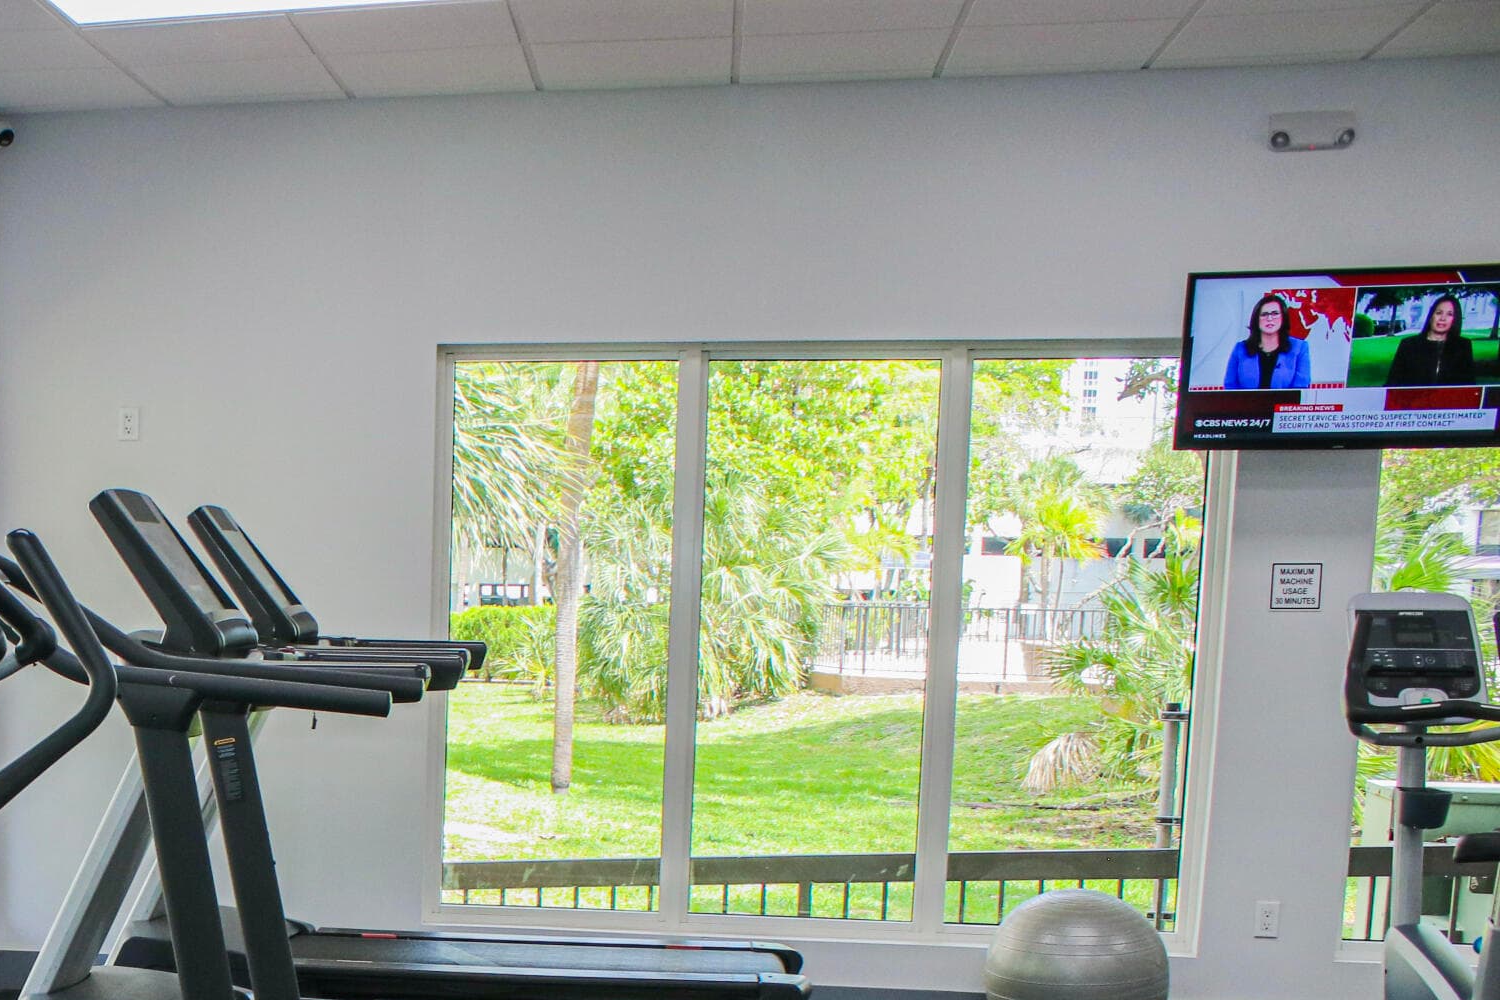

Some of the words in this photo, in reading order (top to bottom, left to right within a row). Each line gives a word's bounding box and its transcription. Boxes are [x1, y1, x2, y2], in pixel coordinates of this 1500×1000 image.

[1414, 412, 1486, 420] "UNDERESTIMATED"
[1202, 419, 1220, 427] CBS
[1221, 419, 1248, 427] NEWS
[1249, 418, 1271, 428] 24/7
[1280, 568, 1315, 576] MAXIMUM
[1282, 587, 1309, 595] USAGE
[1285, 597, 1316, 605] MINUTES
